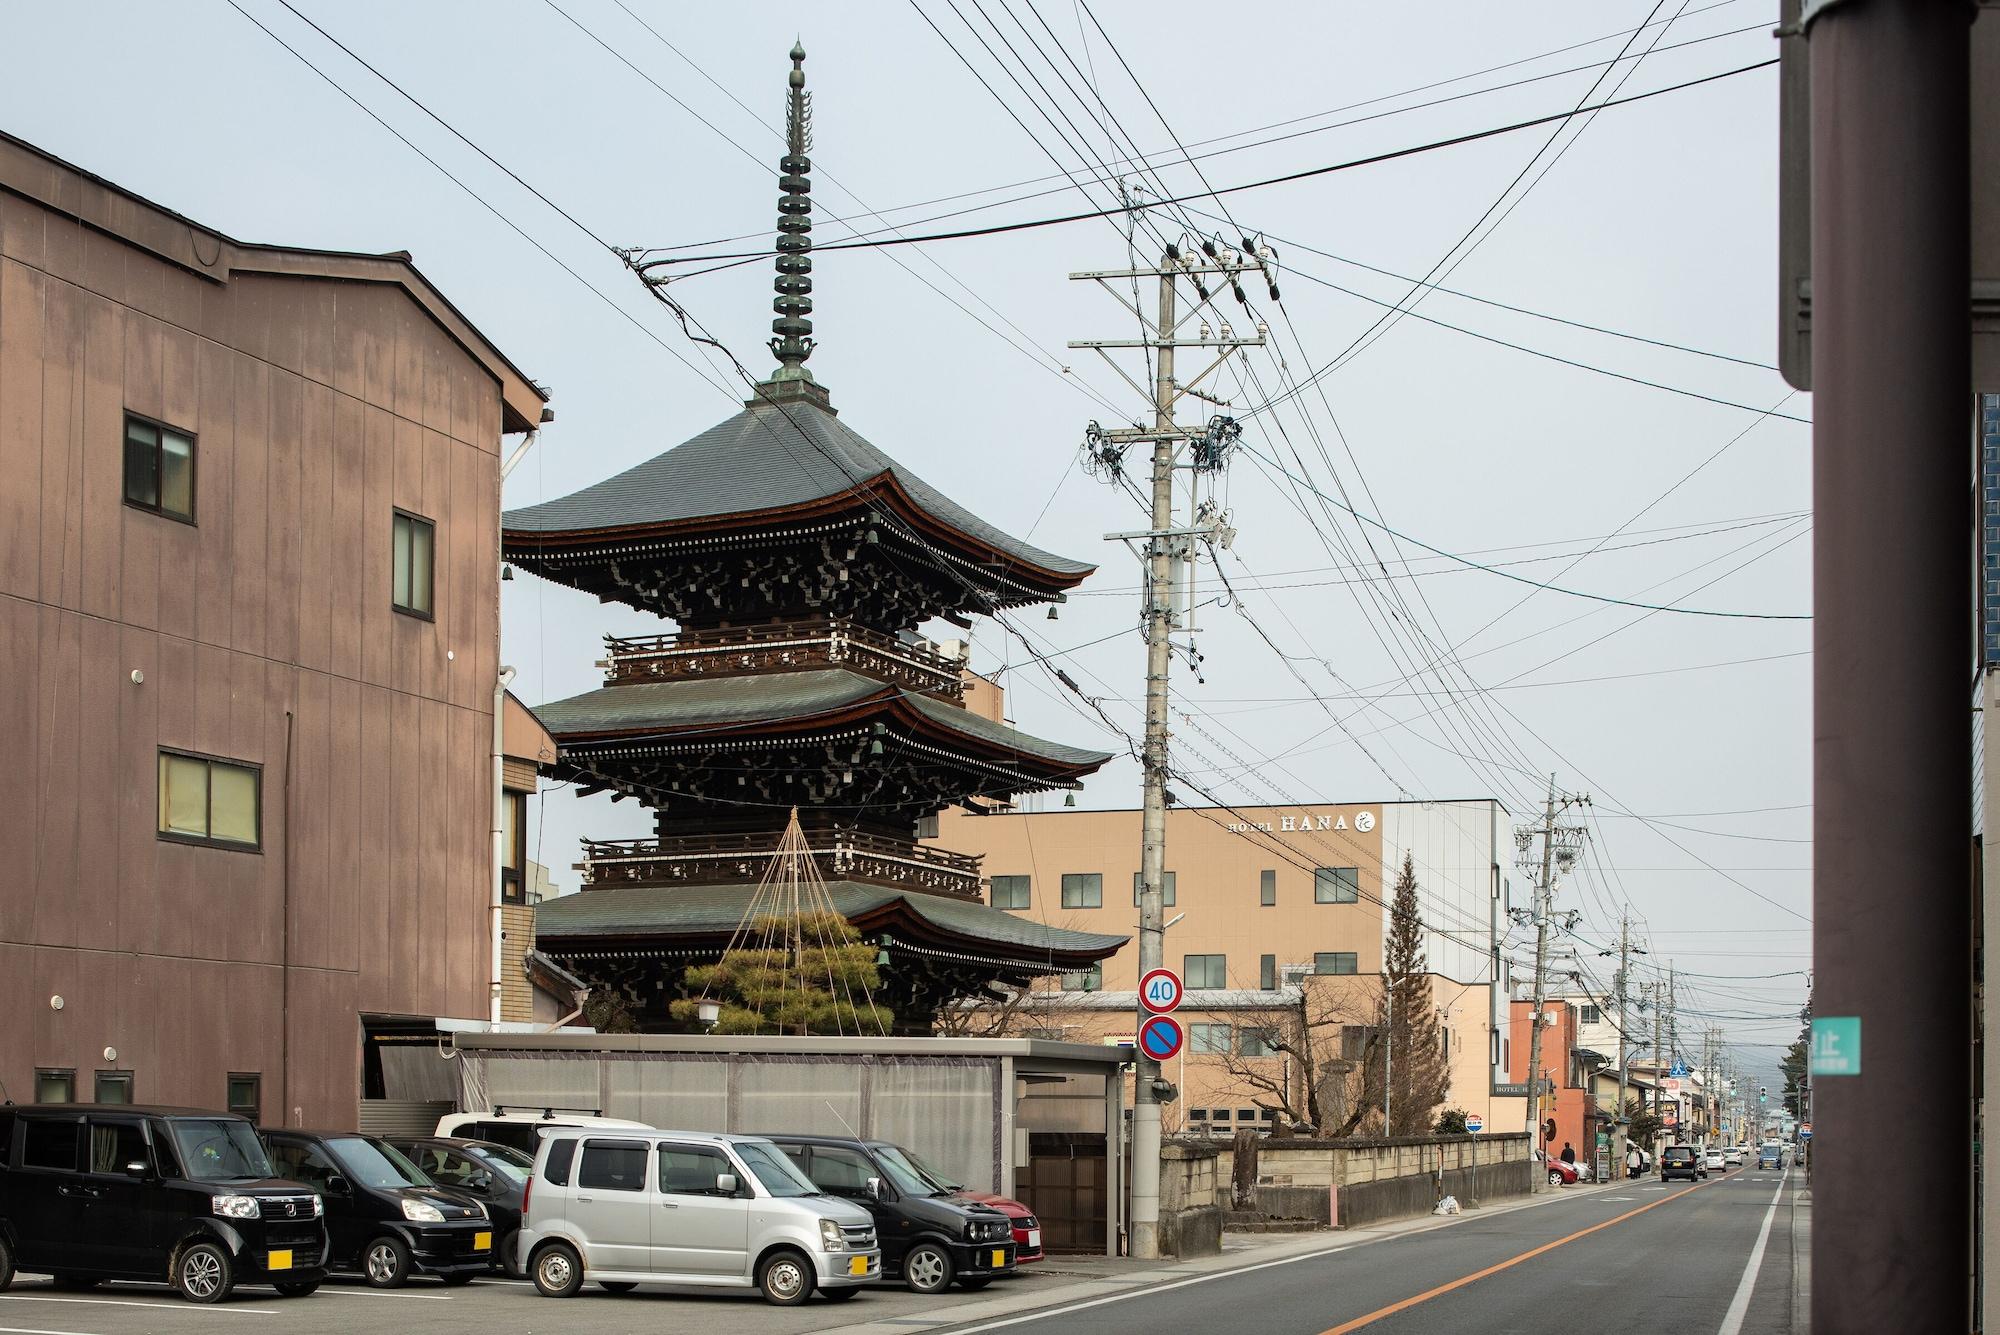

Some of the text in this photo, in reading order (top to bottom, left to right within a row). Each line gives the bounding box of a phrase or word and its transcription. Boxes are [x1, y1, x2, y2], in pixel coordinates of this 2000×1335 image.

[1228, 815, 1349, 833] HOTEL HANA
[1358, 812, 1372, 830] 花
[1149, 981, 1173, 1000] 40
[1812, 1030, 1840, 1056] 止
[1522, 1086, 1542, 1094] HA
